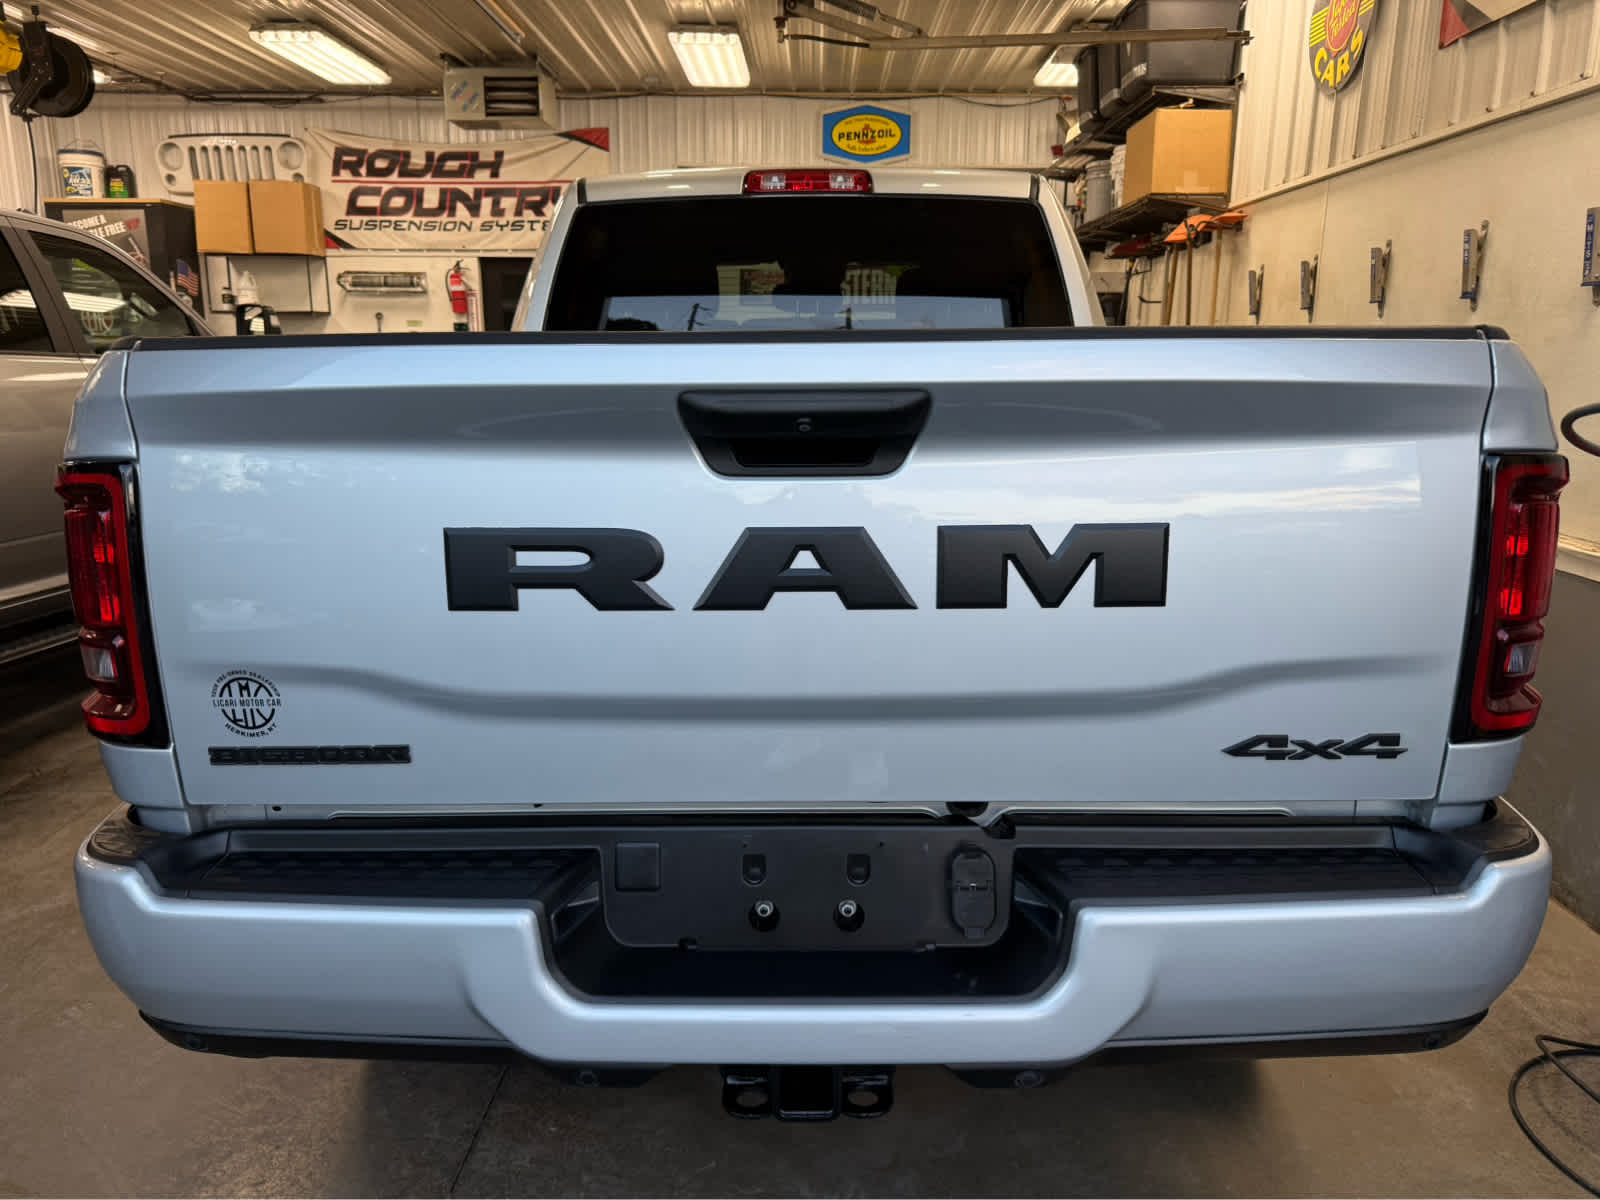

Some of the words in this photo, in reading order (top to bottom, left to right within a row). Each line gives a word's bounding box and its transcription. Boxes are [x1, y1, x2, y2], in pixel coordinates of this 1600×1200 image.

[1314, 24, 1364, 88] CARS
[838, 128, 896, 142] PENNZOIL
[331, 146, 505, 179] ROUGH
[334, 219, 474, 232] SUSPENSION
[443, 522, 1170, 611] RAM
[213, 699, 237, 708] LICARI
[239, 699, 265, 708] MOTOR
[267, 698, 281, 707] CAR
